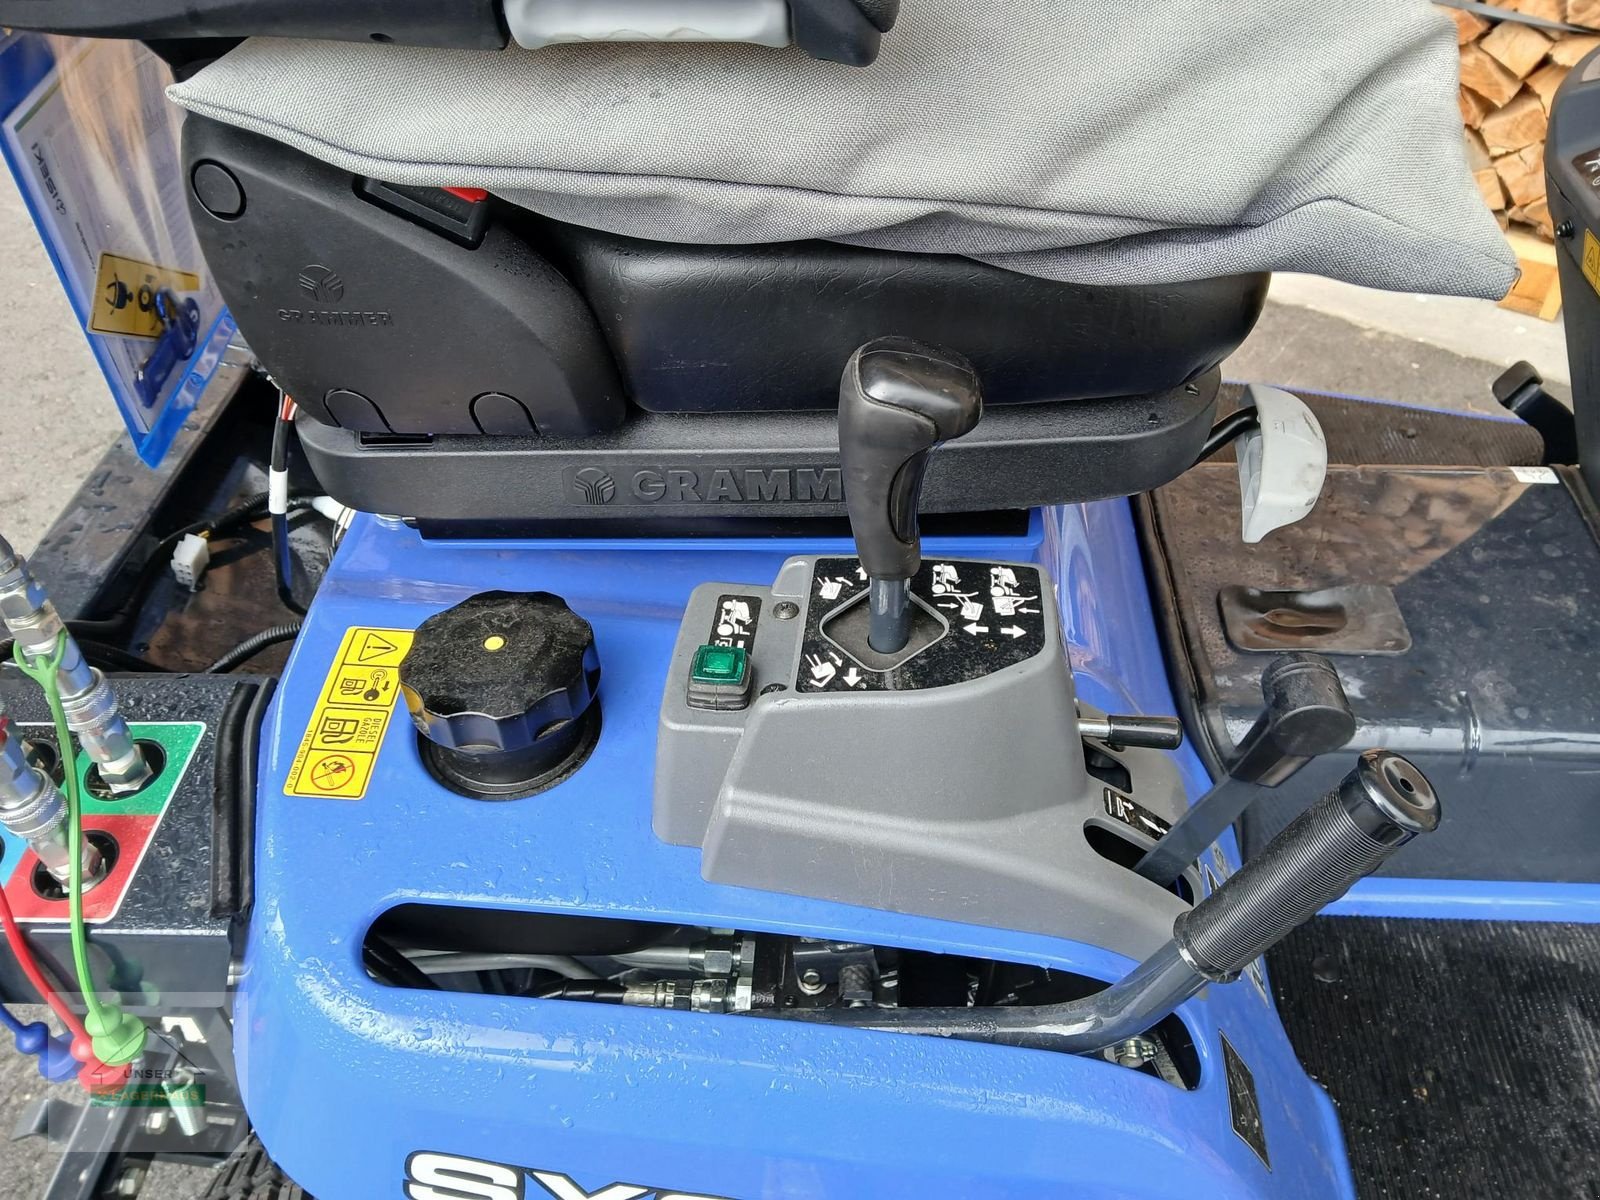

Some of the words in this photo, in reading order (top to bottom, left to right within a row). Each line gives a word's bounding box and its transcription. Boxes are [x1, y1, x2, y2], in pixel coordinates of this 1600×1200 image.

[31, 142, 59, 199] ISEKI
[278, 308, 394, 327] GRAMMER
[631, 467, 846, 502] GRAMM
[356, 717, 372, 744] GAZOLE
[365, 718, 382, 744] DIESEL
